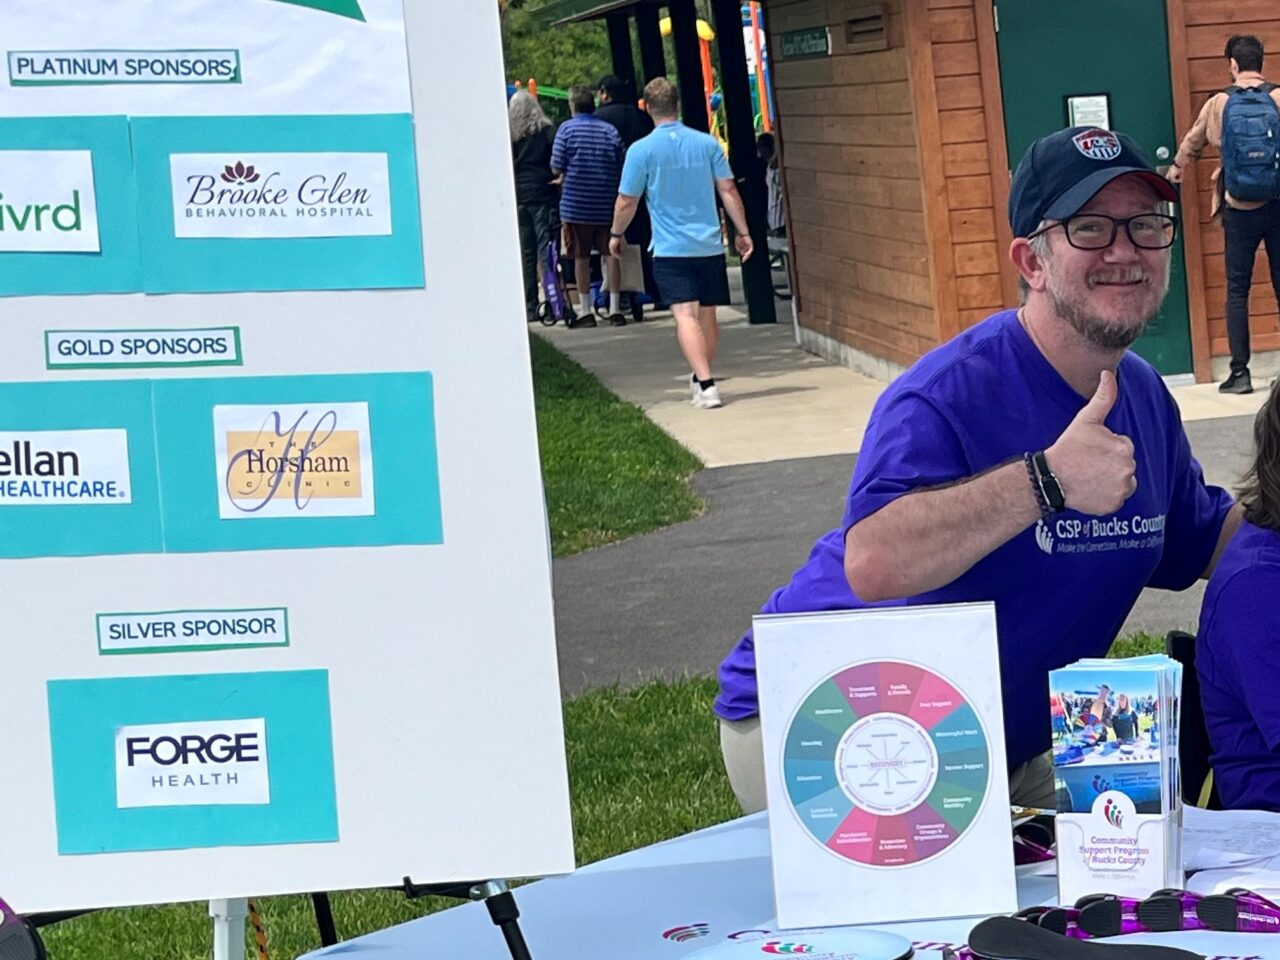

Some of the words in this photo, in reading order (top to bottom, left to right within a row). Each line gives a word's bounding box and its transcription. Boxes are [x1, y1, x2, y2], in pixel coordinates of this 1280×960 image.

[17, 57, 118, 75] PLATINUM
[124, 58, 232, 76] SPONSORS
[186, 171, 289, 206] Brooke
[297, 171, 372, 206] Glen
[185, 207, 288, 218] BEHAVIORAL
[296, 207, 374, 218] HOSPITAL
[57, 339, 115, 356] GOLD
[120, 337, 228, 355] SPONSORS
[245, 448, 350, 474] Horsham
[246, 480, 351, 488] CLINIC
[1056, 519, 1081, 539] CSP
[1092, 517, 1129, 538] Bucks
[109, 621, 176, 640] SILVER
[182, 617, 277, 637] SPONSOR
[126, 732, 260, 767] FORGE
[152, 772, 239, 788] HEALTH
[1090, 835, 1139, 846] Community
[1079, 845, 1112, 857] Support
[1113, 846, 1149, 857] Program
[1092, 855, 1117, 864] Bucks
[1117, 855, 1146, 867] County
